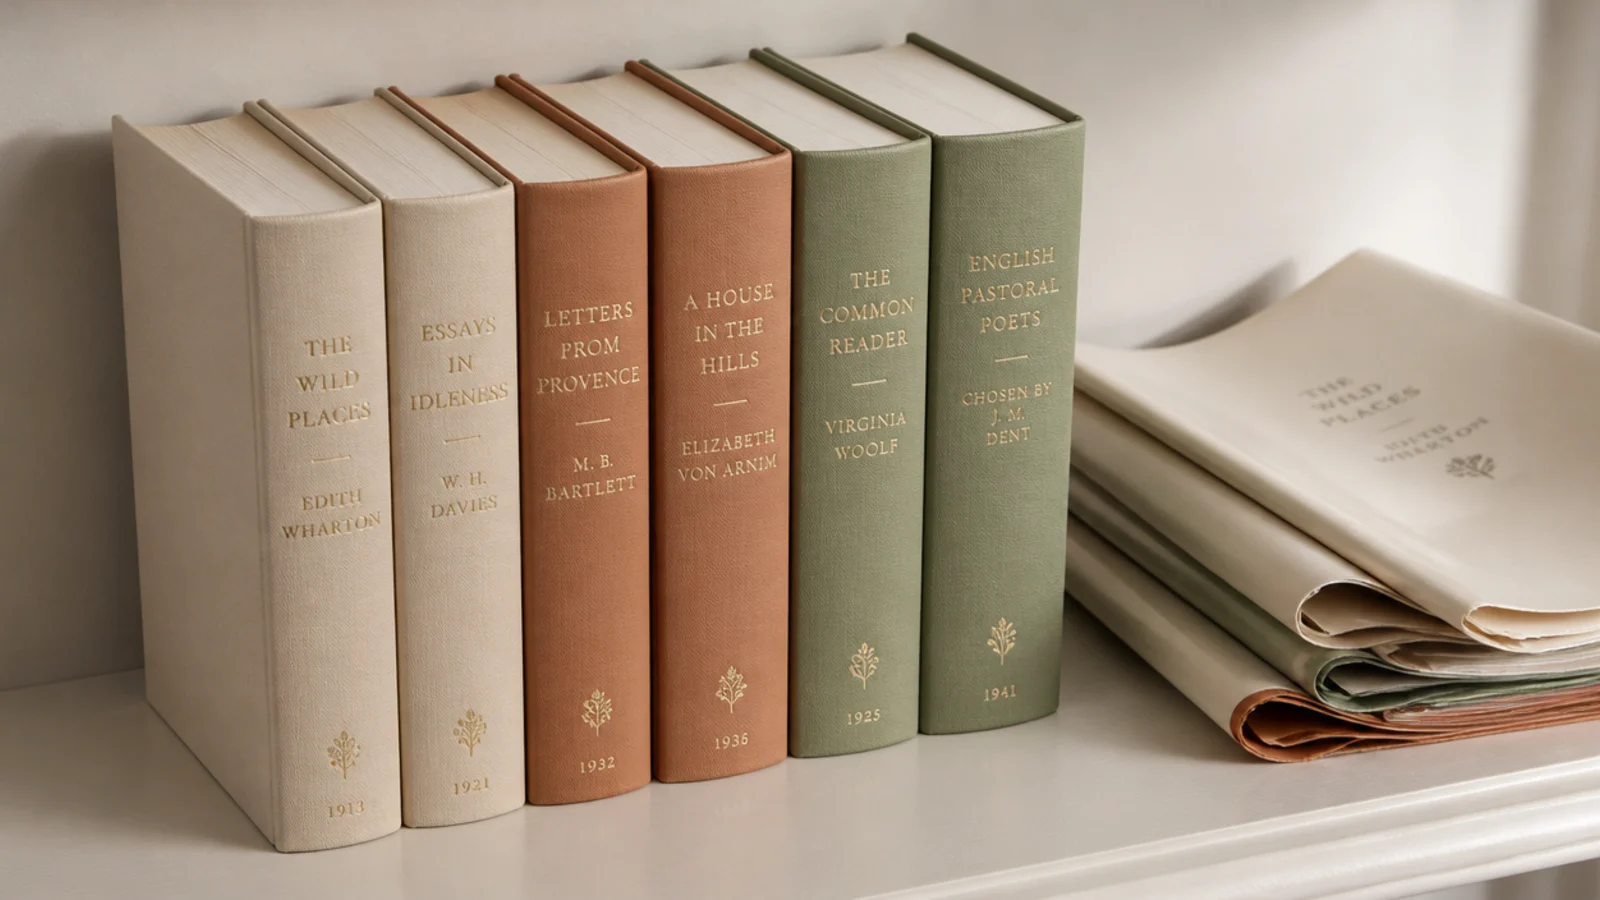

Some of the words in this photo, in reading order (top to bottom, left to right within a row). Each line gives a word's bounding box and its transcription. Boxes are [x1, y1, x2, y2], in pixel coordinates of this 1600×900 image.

[969, 247, 1055, 273] ENGLISH
[850, 269, 891, 290] THE
[961, 277, 1060, 304] PASTORAL
[683, 295, 699, 311] A
[707, 283, 774, 309] HOUSE
[543, 301, 634, 328] LETTERS
[819, 297, 915, 325] COMMON
[979, 310, 1041, 334] POETS
[421, 317, 497, 342] ESSAYS
[695, 324, 718, 343] IN
[724, 317, 764, 339] THE
[304, 335, 352, 357] THE
[561, 336, 620, 360] PROM
[829, 330, 909, 355] READER
[448, 355, 473, 374] IN
[701, 351, 760, 375] HILLS
[297, 370, 360, 393] WILD
[536, 366, 641, 395] PROVENCE
[410, 382, 509, 411] IDLENESS
[961, 385, 1029, 406] CHOSEN
[1034, 382, 1053, 397] BY
[288, 401, 372, 429] PLACES
[825, 412, 907, 435] VIRGINIA
[682, 428, 776, 456] ELIZABETH
[986, 426, 1031, 446] DENT
[835, 438, 898, 460] WOOLF
[573, 457, 594, 473] M.
[600, 454, 614, 469] B.
[678, 464, 717, 482] VON
[722, 453, 777, 478] ARNIM
[442, 474, 463, 489] W.
[469, 471, 487, 486] H.
[545, 474, 637, 502] BARTLETT
[302, 488, 363, 511] EDITH
[431, 495, 498, 519] DAVIES
[282, 511, 381, 540] WHARTON
[984, 685, 1017, 702] 1941
[847, 708, 881, 726] 1925
[715, 732, 749, 750] 1936
[579, 756, 616, 775] 1932
[453, 777, 491, 795] 1921
[327, 800, 365, 819] 1913
